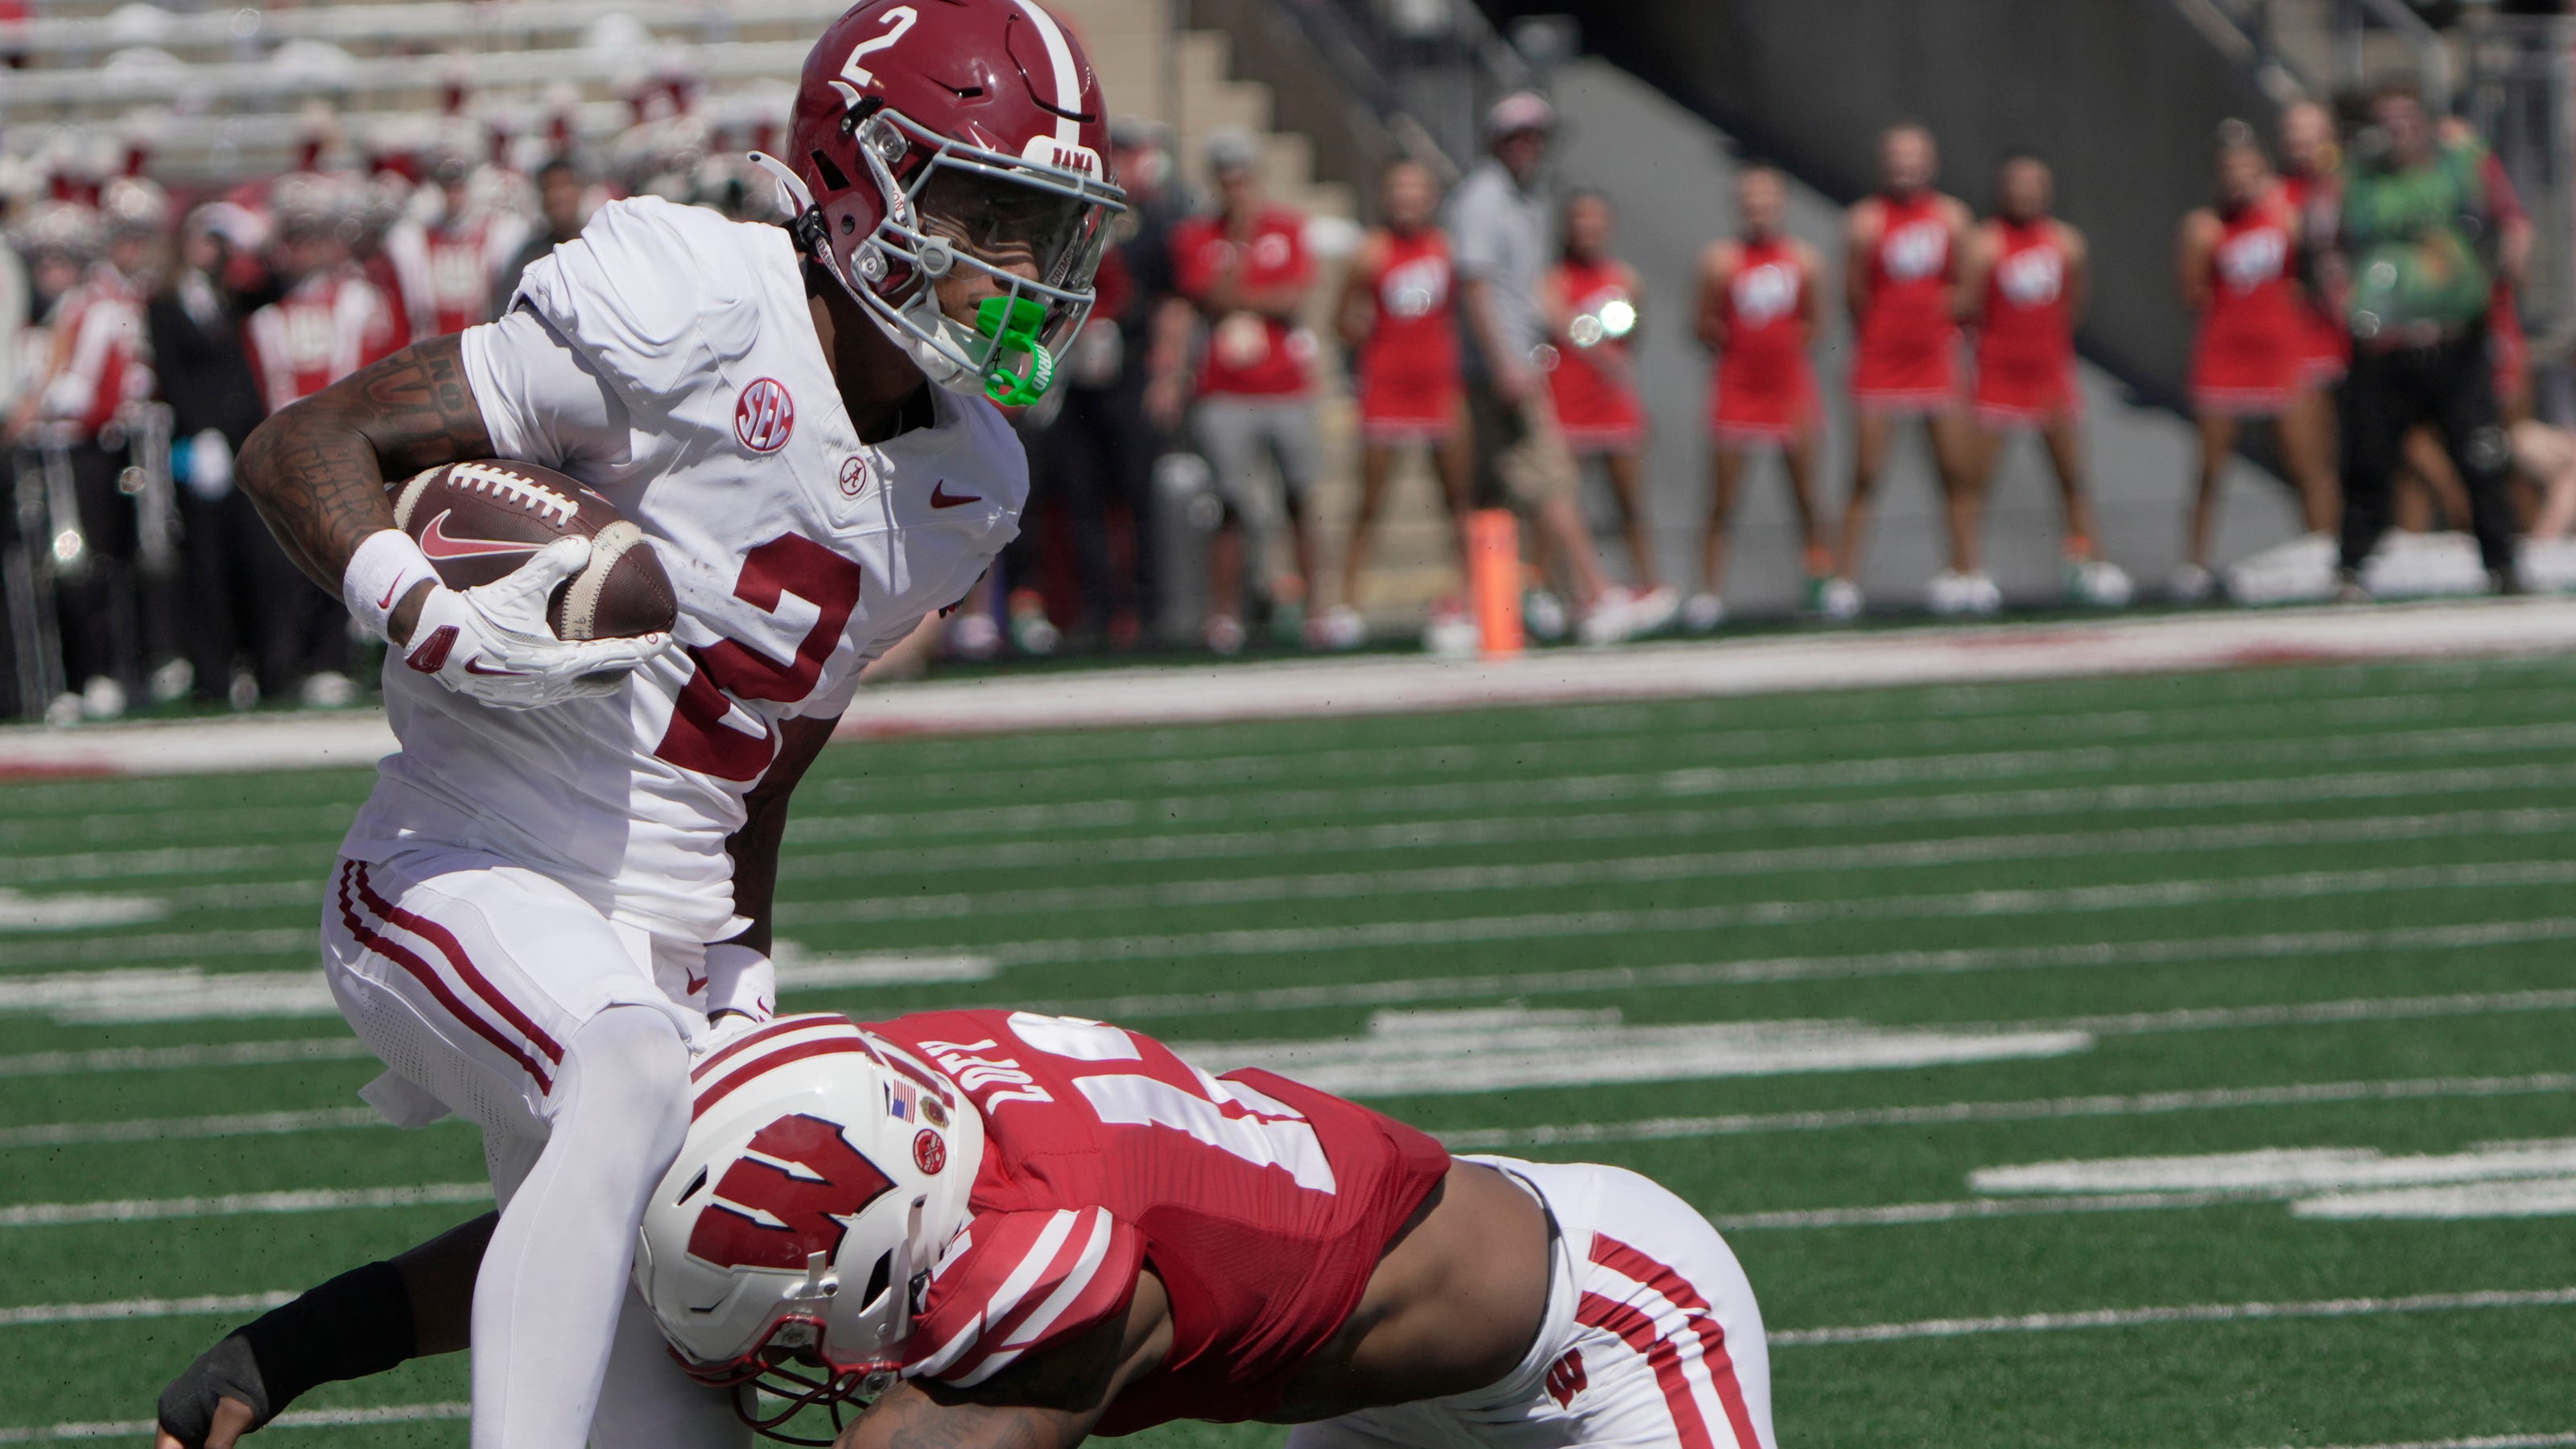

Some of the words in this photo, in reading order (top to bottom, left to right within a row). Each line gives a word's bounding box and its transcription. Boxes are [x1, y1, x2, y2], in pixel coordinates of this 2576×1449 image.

[840, 6, 918, 87] 2
[1052, 147, 1092, 171] BAMA
[738, 381, 793, 448] SEC
[842, 462, 863, 489] A
[653, 530, 861, 782] 2
[917, 1038, 1055, 1116] LOFY
[686, 1113, 901, 1270] W
